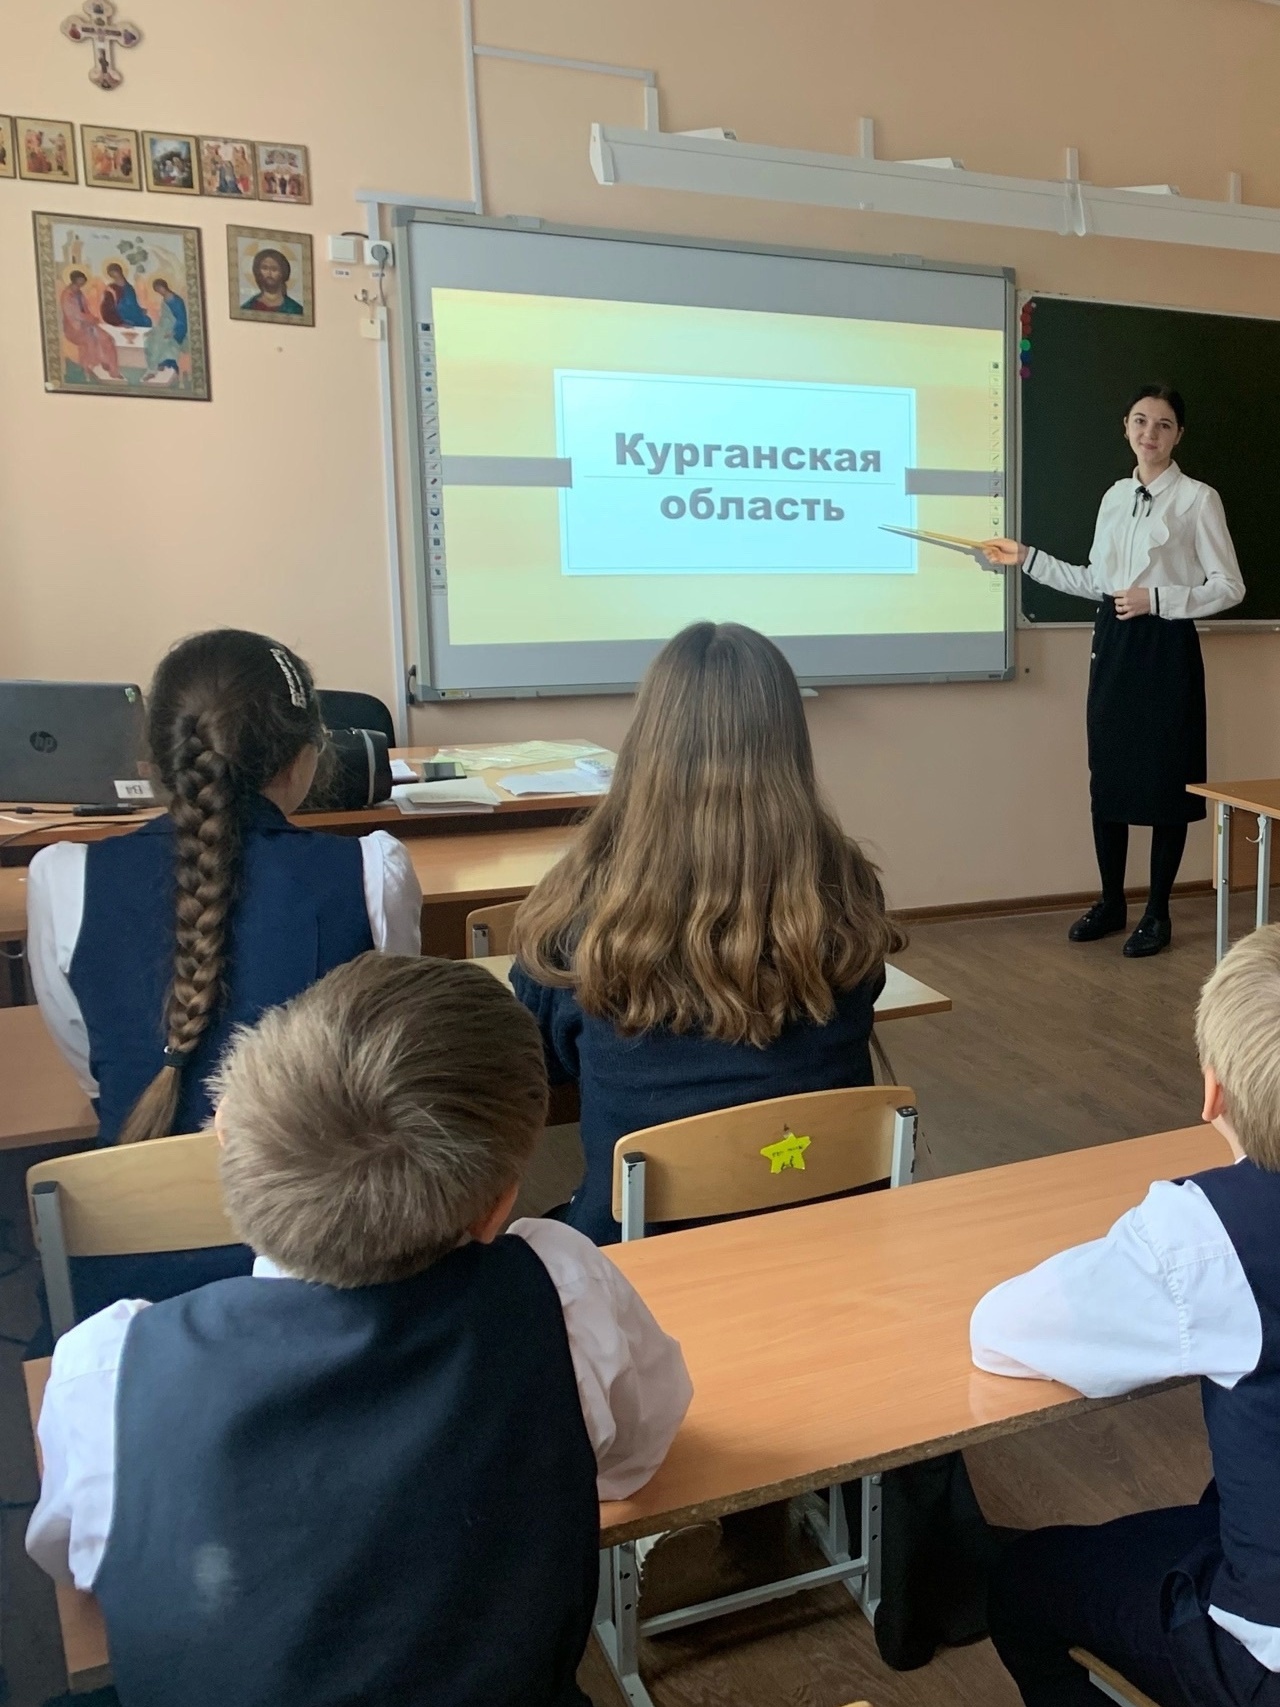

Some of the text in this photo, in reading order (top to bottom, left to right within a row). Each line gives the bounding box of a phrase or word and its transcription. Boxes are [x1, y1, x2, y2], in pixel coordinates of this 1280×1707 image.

[615, 432, 881, 475] Курганская
[660, 487, 845, 521] область
[32, 731, 56, 753] hp
